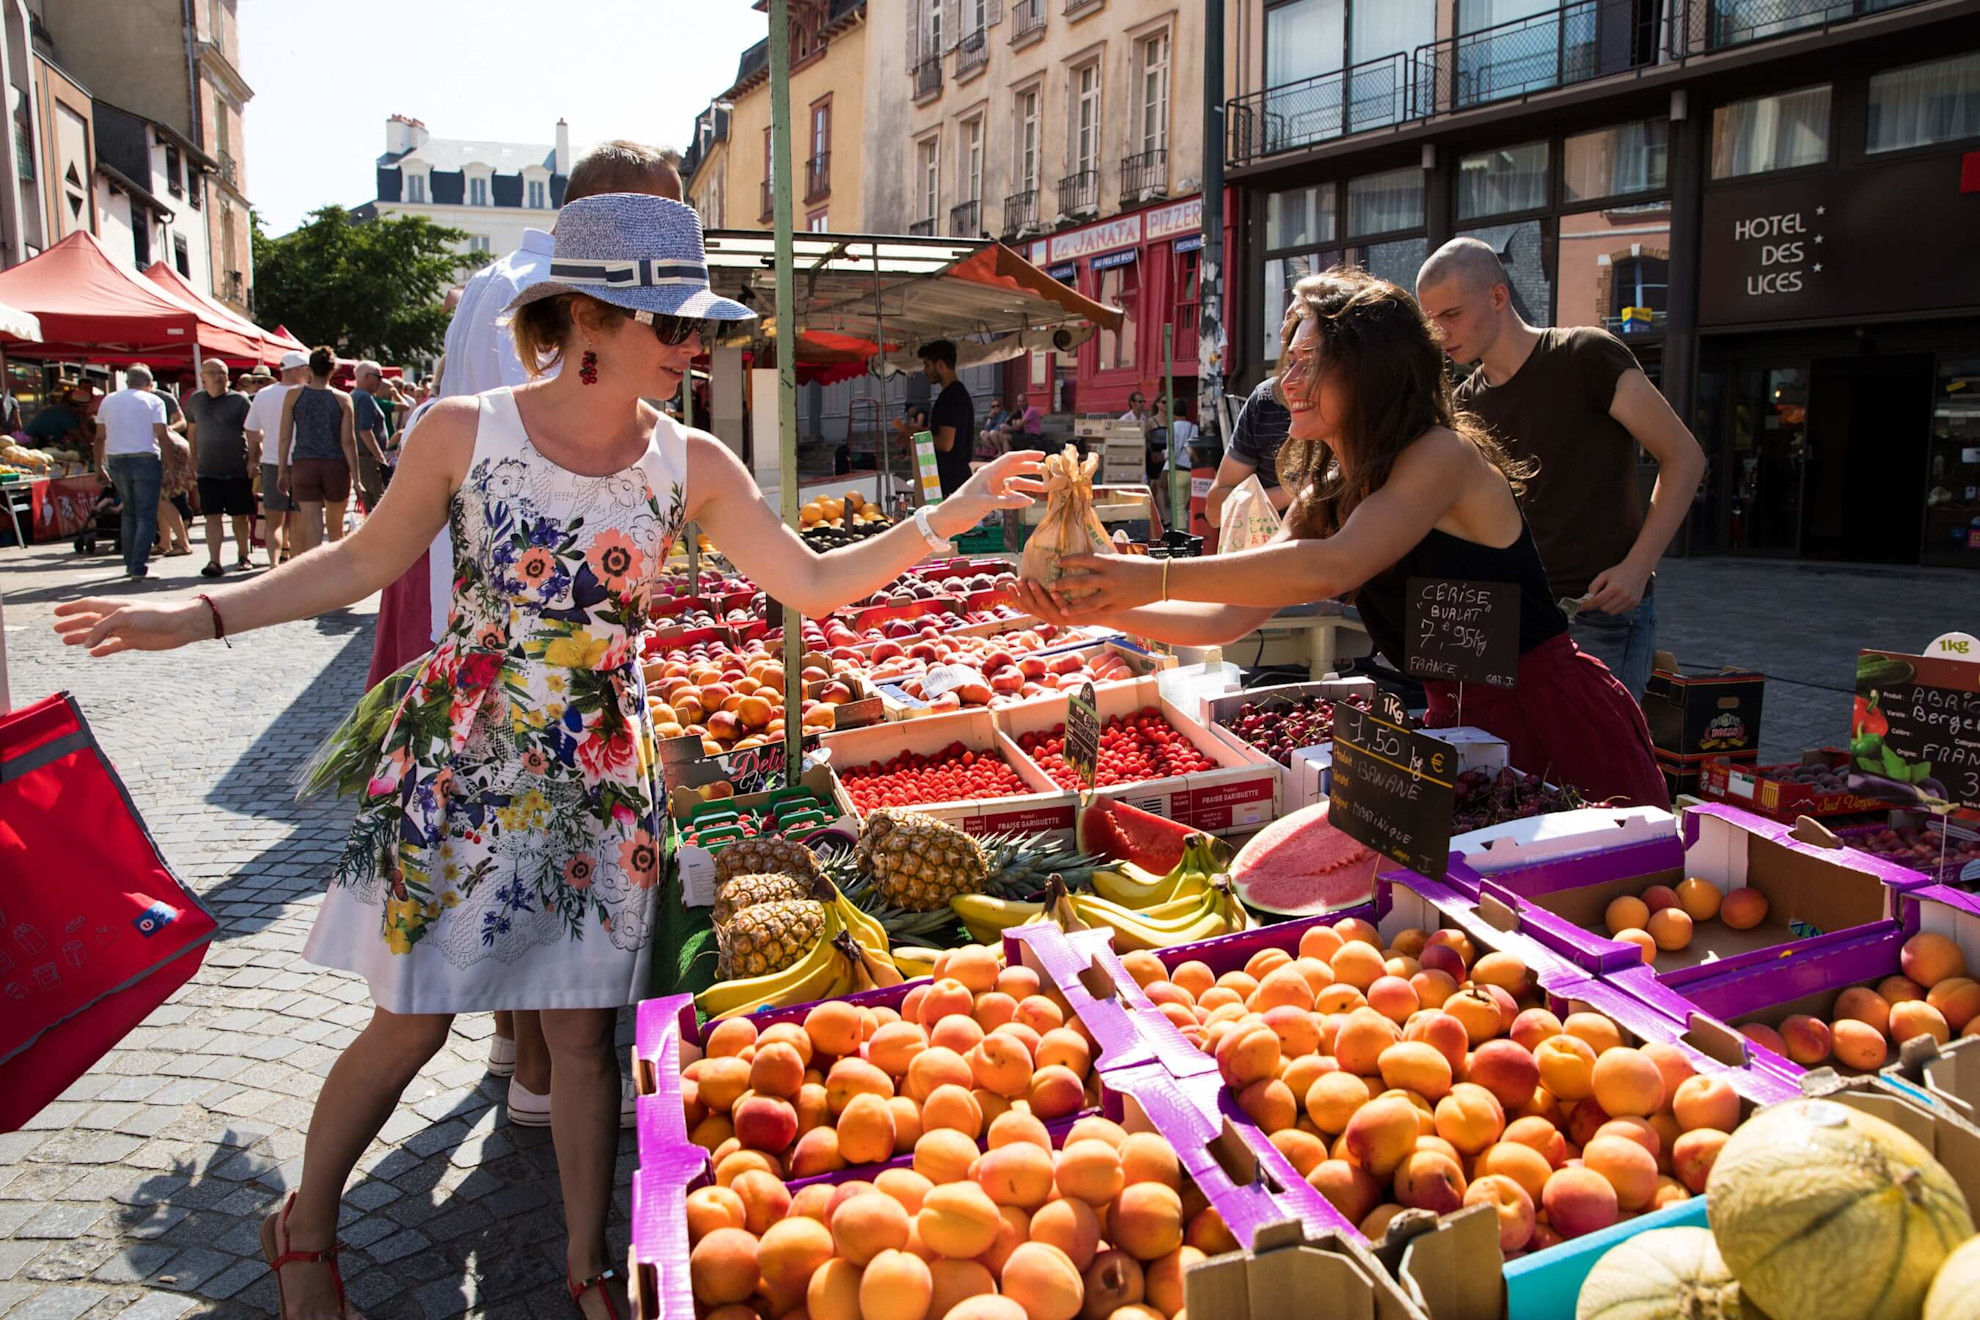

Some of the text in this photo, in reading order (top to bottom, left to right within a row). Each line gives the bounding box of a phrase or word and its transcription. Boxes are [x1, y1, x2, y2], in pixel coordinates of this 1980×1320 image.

[1150, 203, 1201, 236] PIZZER
[1735, 212, 1807, 241] HOTEL
[1761, 241, 1804, 266] DES
[1094, 259, 1104, 268] AU
[1747, 271, 1803, 296] LICES
[1939, 639, 1969, 654] 1kg
[1410, 656, 1458, 675] FRANCE
[1357, 760, 1423, 801] BANANE
[1202, 794, 1223, 805] FRAISE
[1817, 797, 1839, 812] Sud
[997, 821, 1020, 831] FRAISE
